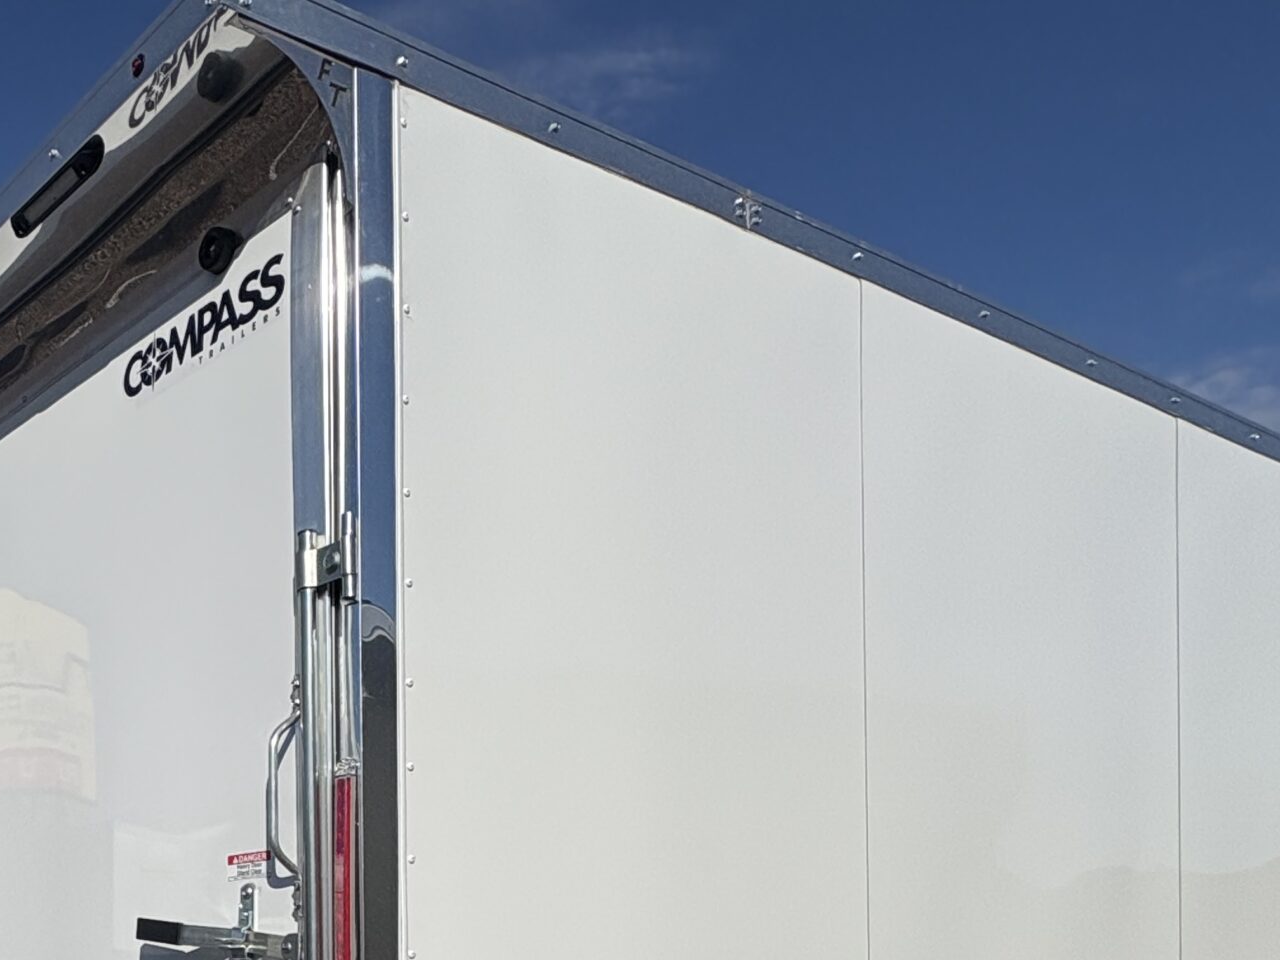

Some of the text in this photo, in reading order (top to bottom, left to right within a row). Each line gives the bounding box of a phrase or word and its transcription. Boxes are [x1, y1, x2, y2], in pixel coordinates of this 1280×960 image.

[124, 253, 285, 397] COMPASS
[198, 307, 281, 364] TRAILERS
[238, 852, 267, 863] DANGER
